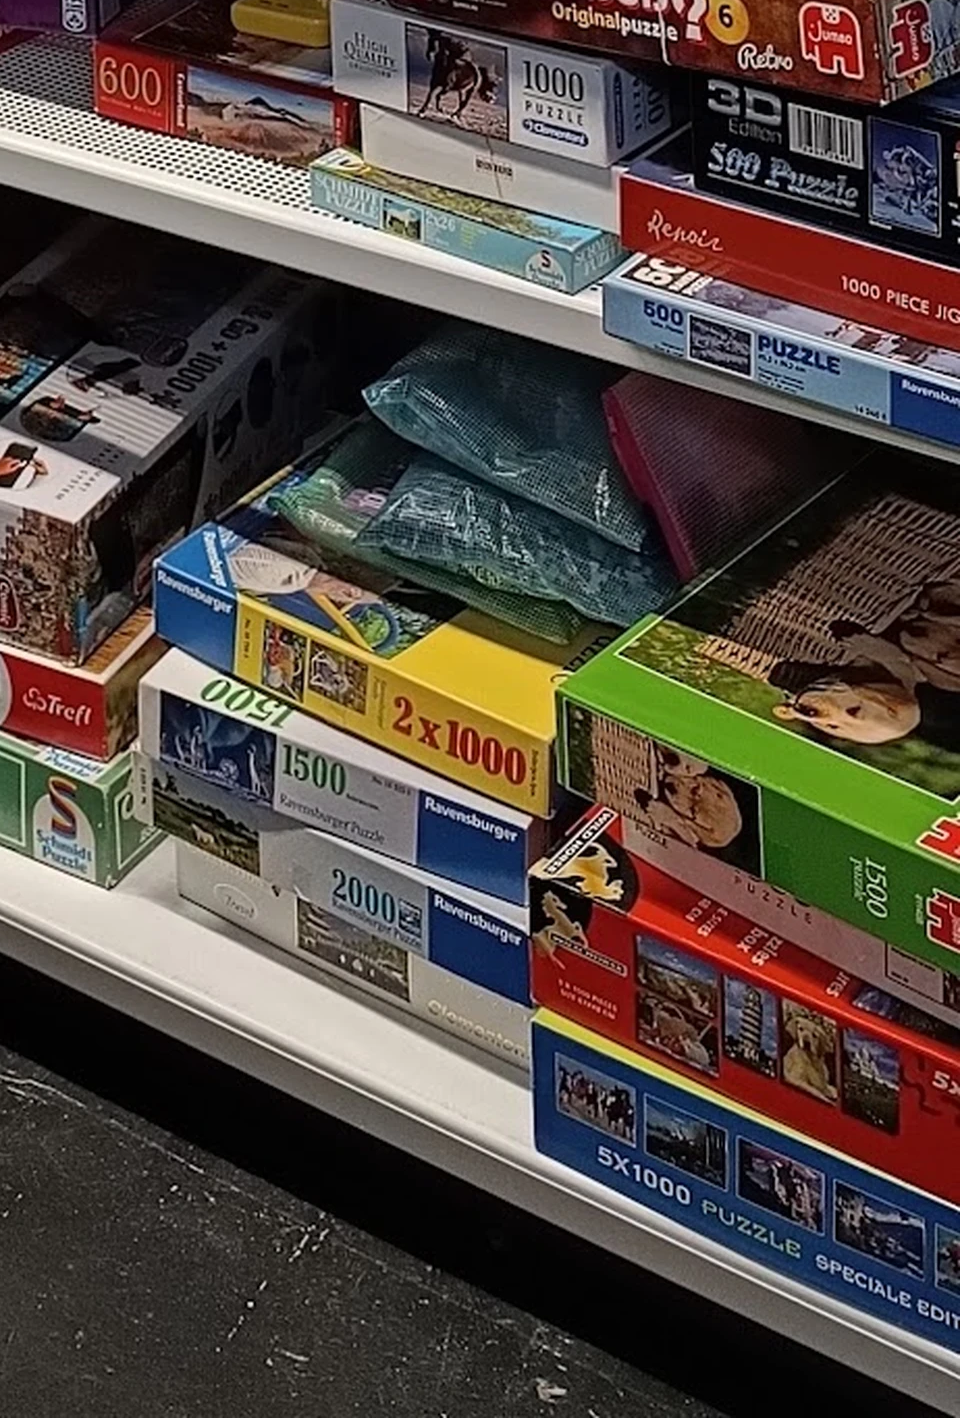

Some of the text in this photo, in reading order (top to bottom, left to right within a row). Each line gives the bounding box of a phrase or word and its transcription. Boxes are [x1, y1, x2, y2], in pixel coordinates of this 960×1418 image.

[551, 1, 679, 43] Originalpuzzle
[715, 5, 733, 29] 6
[737, 43, 794, 73] Retro
[98, 56, 163, 106] 600
[522, 59, 586, 103] 1000
[524, 100, 586, 127] PUZZLE
[706, 79, 783, 128] 3D
[708, 141, 761, 183] 500
[646, 208, 725, 253] Renoir
[642, 300, 685, 327] 500
[840, 274, 931, 316] 1000 PIECE
[757, 334, 842, 376] PUZZLE
[155, 568, 234, 616] Ravensburger
[47, 695, 93, 726] Trefl
[392, 694, 528, 787] 2 1000
[280, 742, 348, 797] 1500
[423, 792, 519, 844] Ravensburger
[331, 867, 398, 925] 2000
[433, 892, 524, 947] Ravensburger
[700, 1195, 914, 1312] PUZZLE SPECIALE
